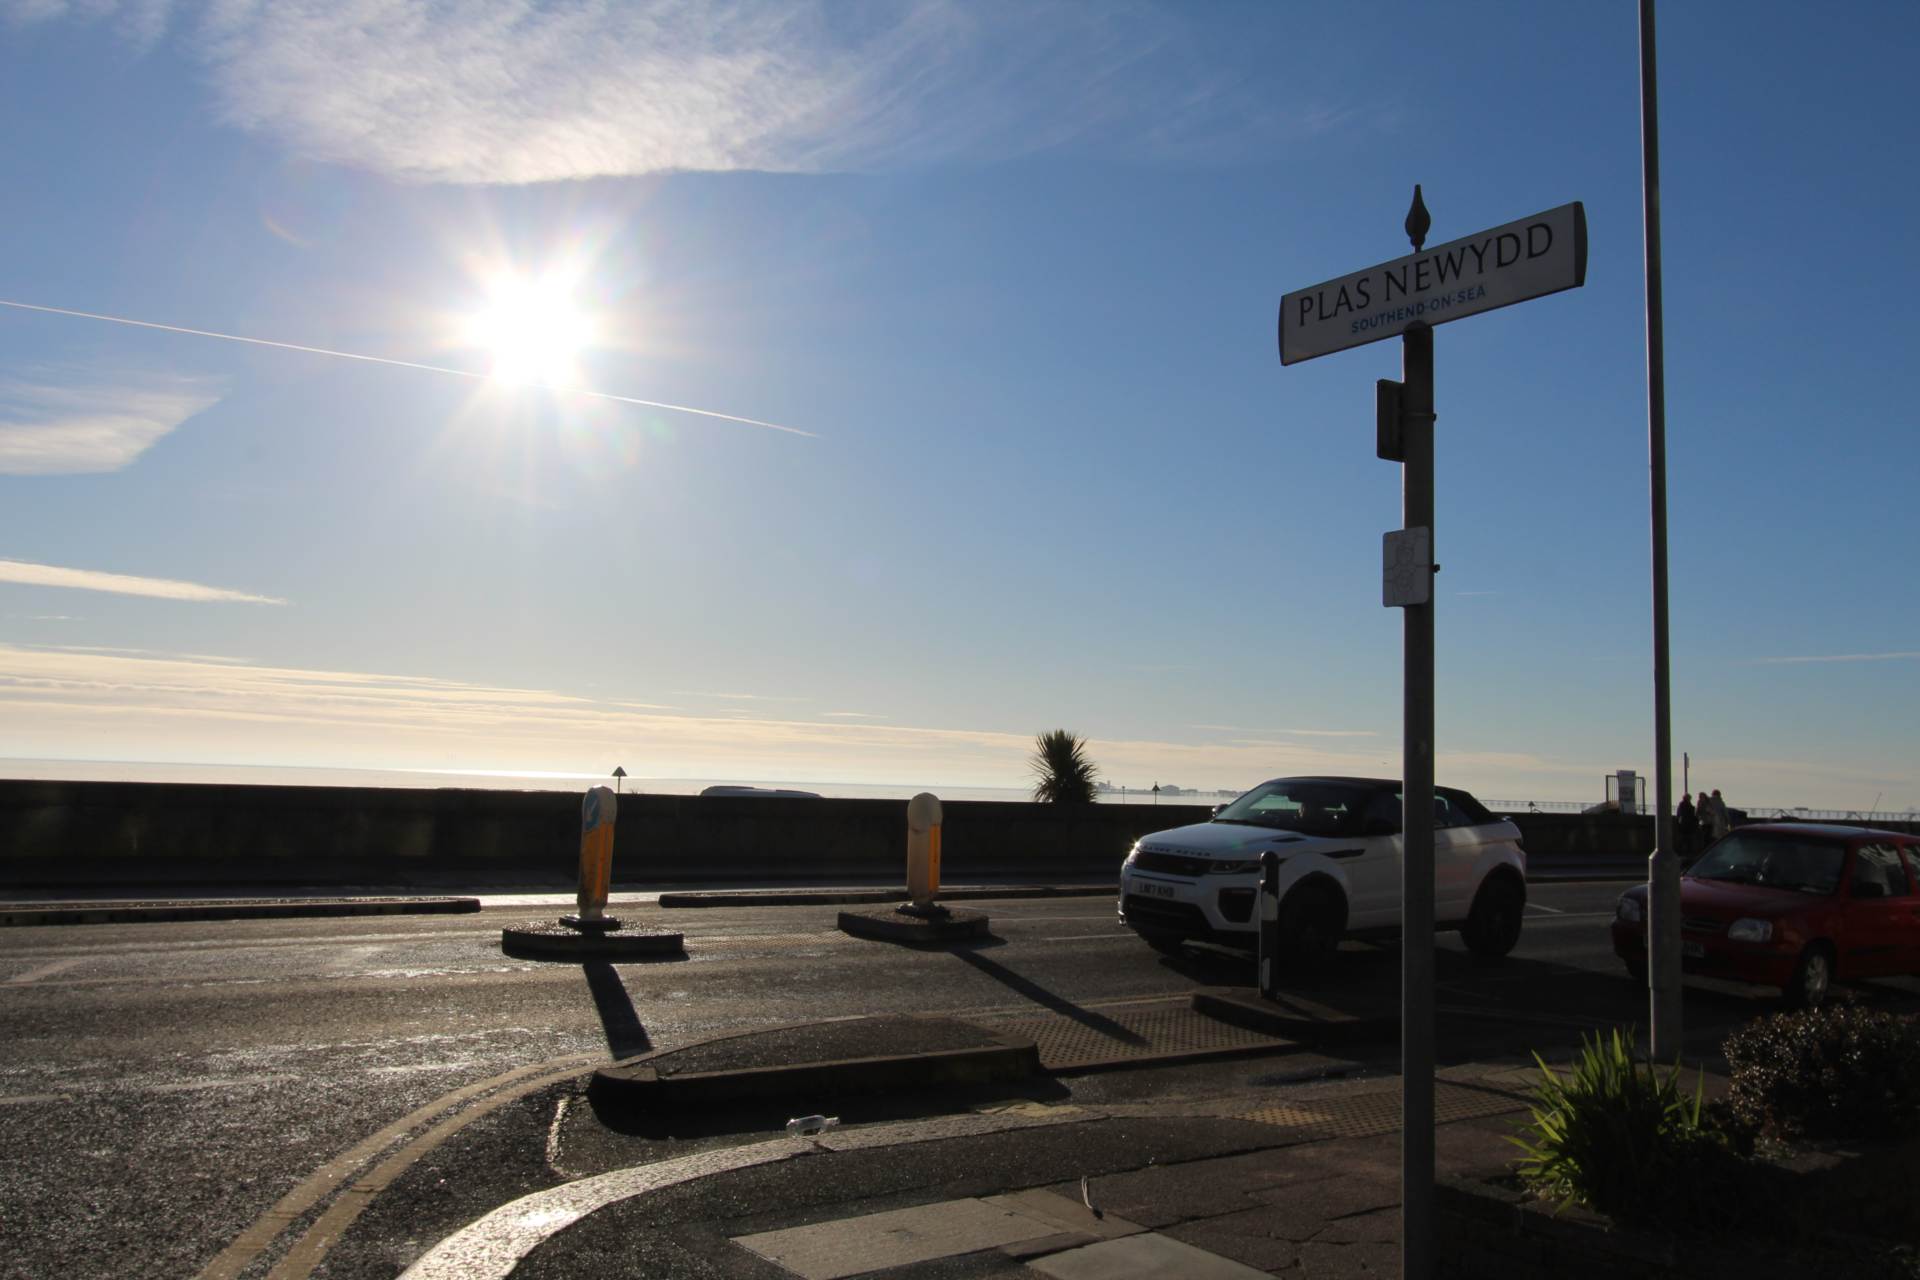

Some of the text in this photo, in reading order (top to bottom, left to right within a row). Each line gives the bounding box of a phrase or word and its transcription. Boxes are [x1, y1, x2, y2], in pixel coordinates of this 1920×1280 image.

[1299, 223, 1553, 327] PLAS NEWYDD
[1351, 285, 1486, 333] SOUTHEND-ON-SEA
